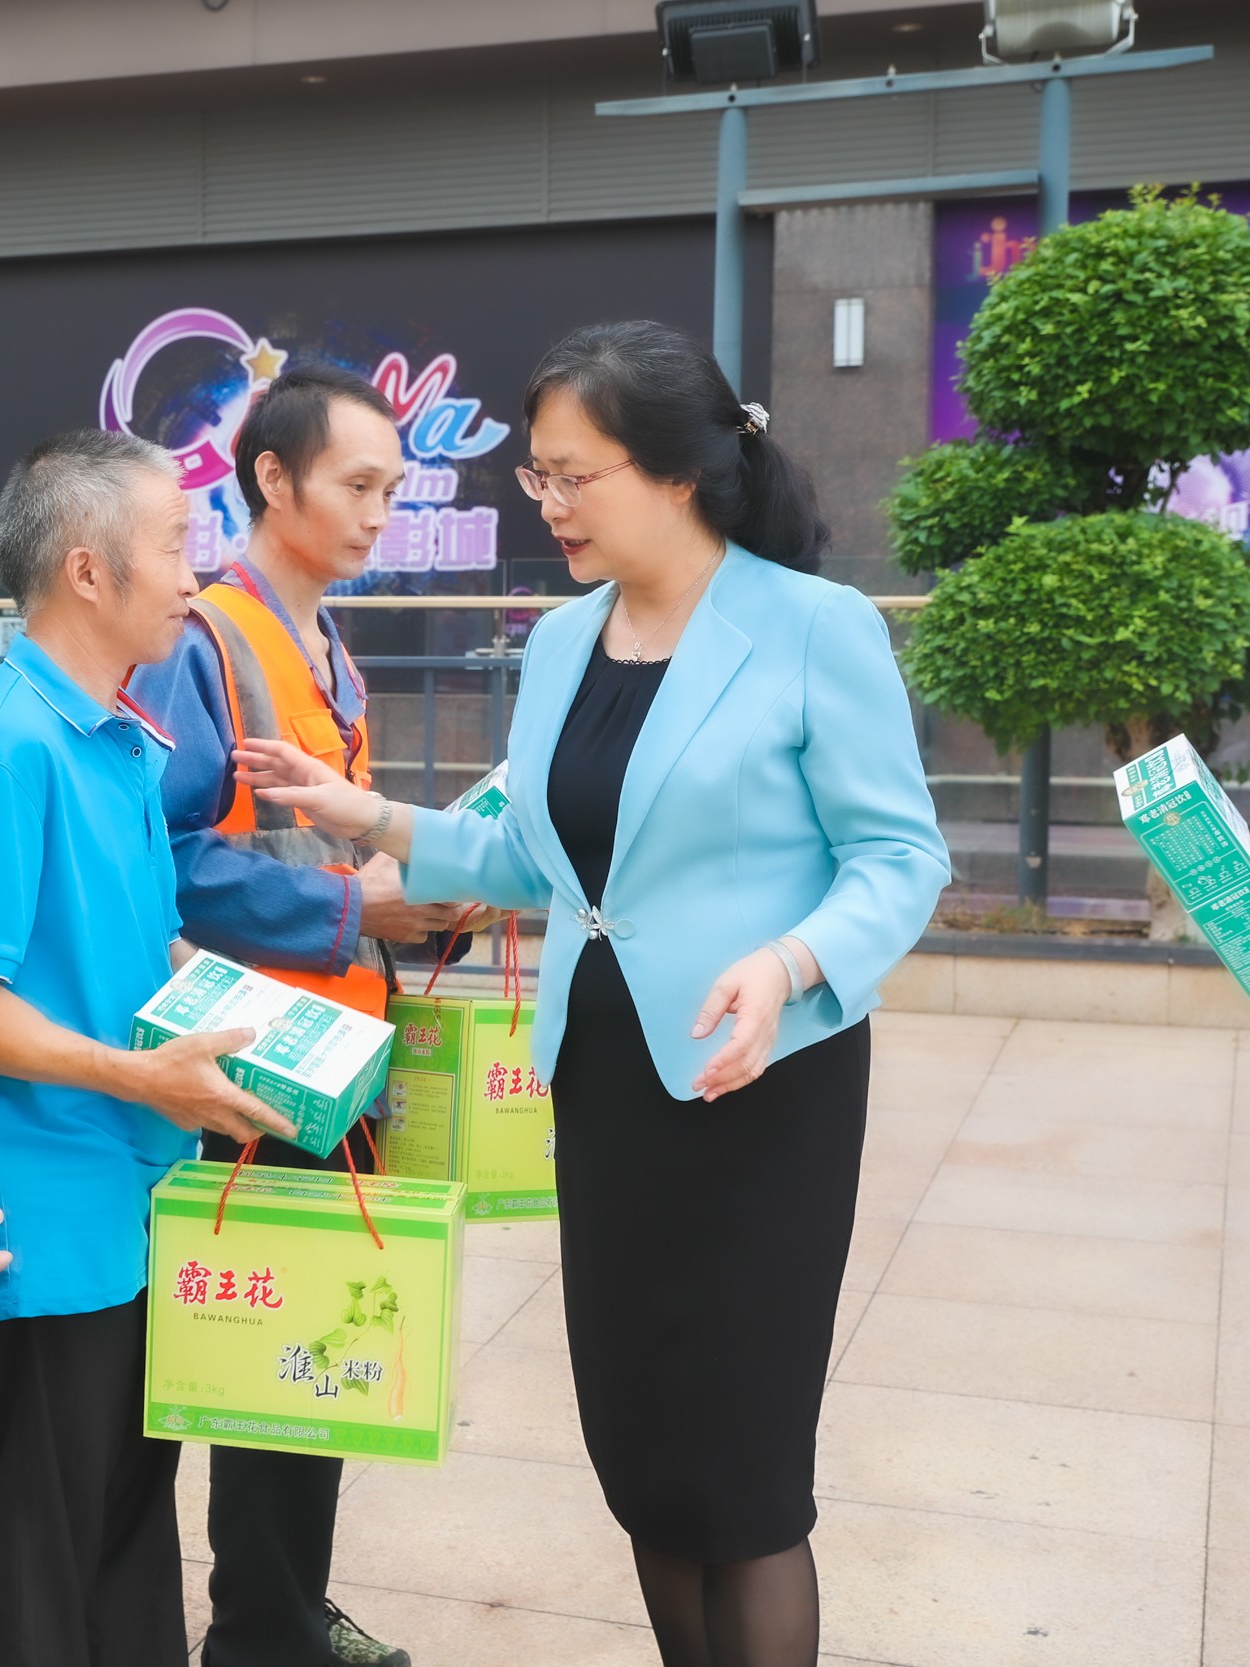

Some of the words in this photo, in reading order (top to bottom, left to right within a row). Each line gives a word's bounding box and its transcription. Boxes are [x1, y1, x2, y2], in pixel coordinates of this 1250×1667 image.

[402, 1023, 443, 1047] 霸王花
[495, 1107, 538, 1115] BAWANGHUA
[173, 1260, 283, 1310] 霸王花
[193, 1312, 263, 1327] BAWANGHUA
[198, 1416, 330, 1441] 广东霸王花食品有限公司
